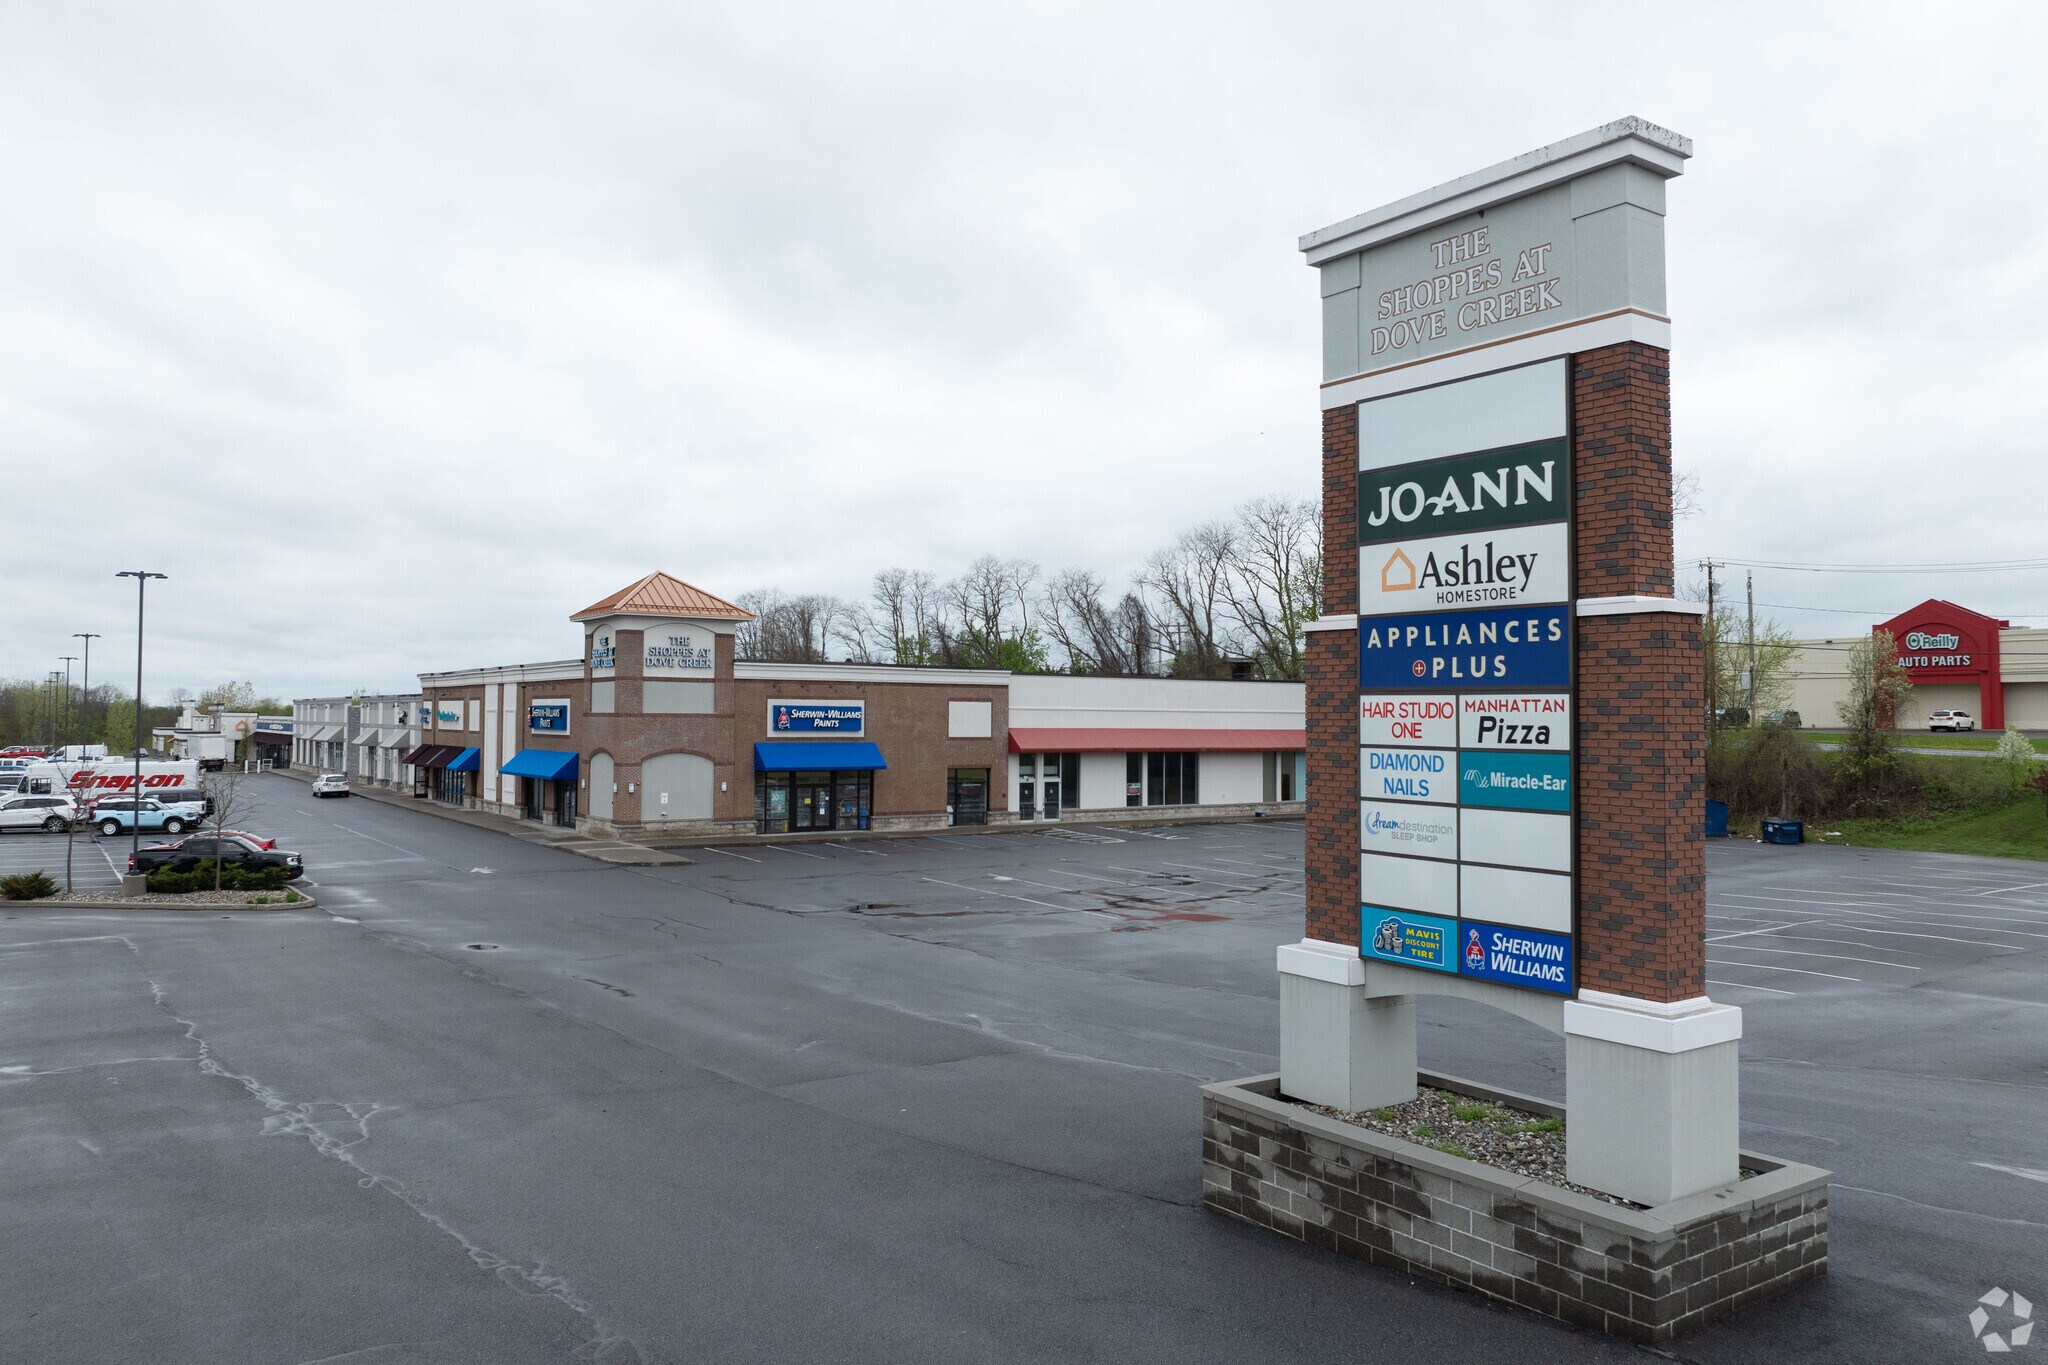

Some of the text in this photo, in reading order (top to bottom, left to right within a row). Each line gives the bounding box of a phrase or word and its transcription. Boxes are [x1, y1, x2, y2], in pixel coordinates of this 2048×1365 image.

[1429, 225, 1491, 269] THE
[1377, 242, 1552, 320] SHOPPES AT
[1371, 277, 1562, 356] DOVE CREEK
[1418, 541, 1538, 593] Ashley
[1436, 586, 1517, 604] HOMESTORE
[669, 635, 690, 646] THE
[1367, 618, 1562, 649] APPLIANCES
[1907, 632, 1958, 650] O'Reilly
[648, 647, 711, 657] SHOPPES AT
[1898, 655, 1971, 667] AUTO PARTS
[645, 657, 712, 668] DOVE CREEK
[1432, 655, 1507, 678] PLUS
[791, 709, 862, 719] SHERWIN-WILLIAMS
[1362, 701, 1455, 719] HAIR STUDIO
[1464, 698, 1565, 713] MANHATTAN
[813, 718, 839, 728] PAINTS
[1391, 721, 1423, 739] ONE
[1477, 715, 1551, 745] Pizza
[1370, 752, 1445, 773] DIAMOND
[66, 770, 185, 792] Snap-on
[1384, 777, 1430, 797] NAILS
[1490, 771, 1567, 791] Miracle-Ear
[1391, 831, 1438, 843] SLEEP SHOP
[1405, 928, 1440, 941] MAVIS
[1405, 938, 1440, 950] DISCOUNT
[1491, 932, 1564, 962] SHERWIN
[1411, 948, 1434, 959] TIRE
[1491, 952, 1565, 982] WILLIAMS
